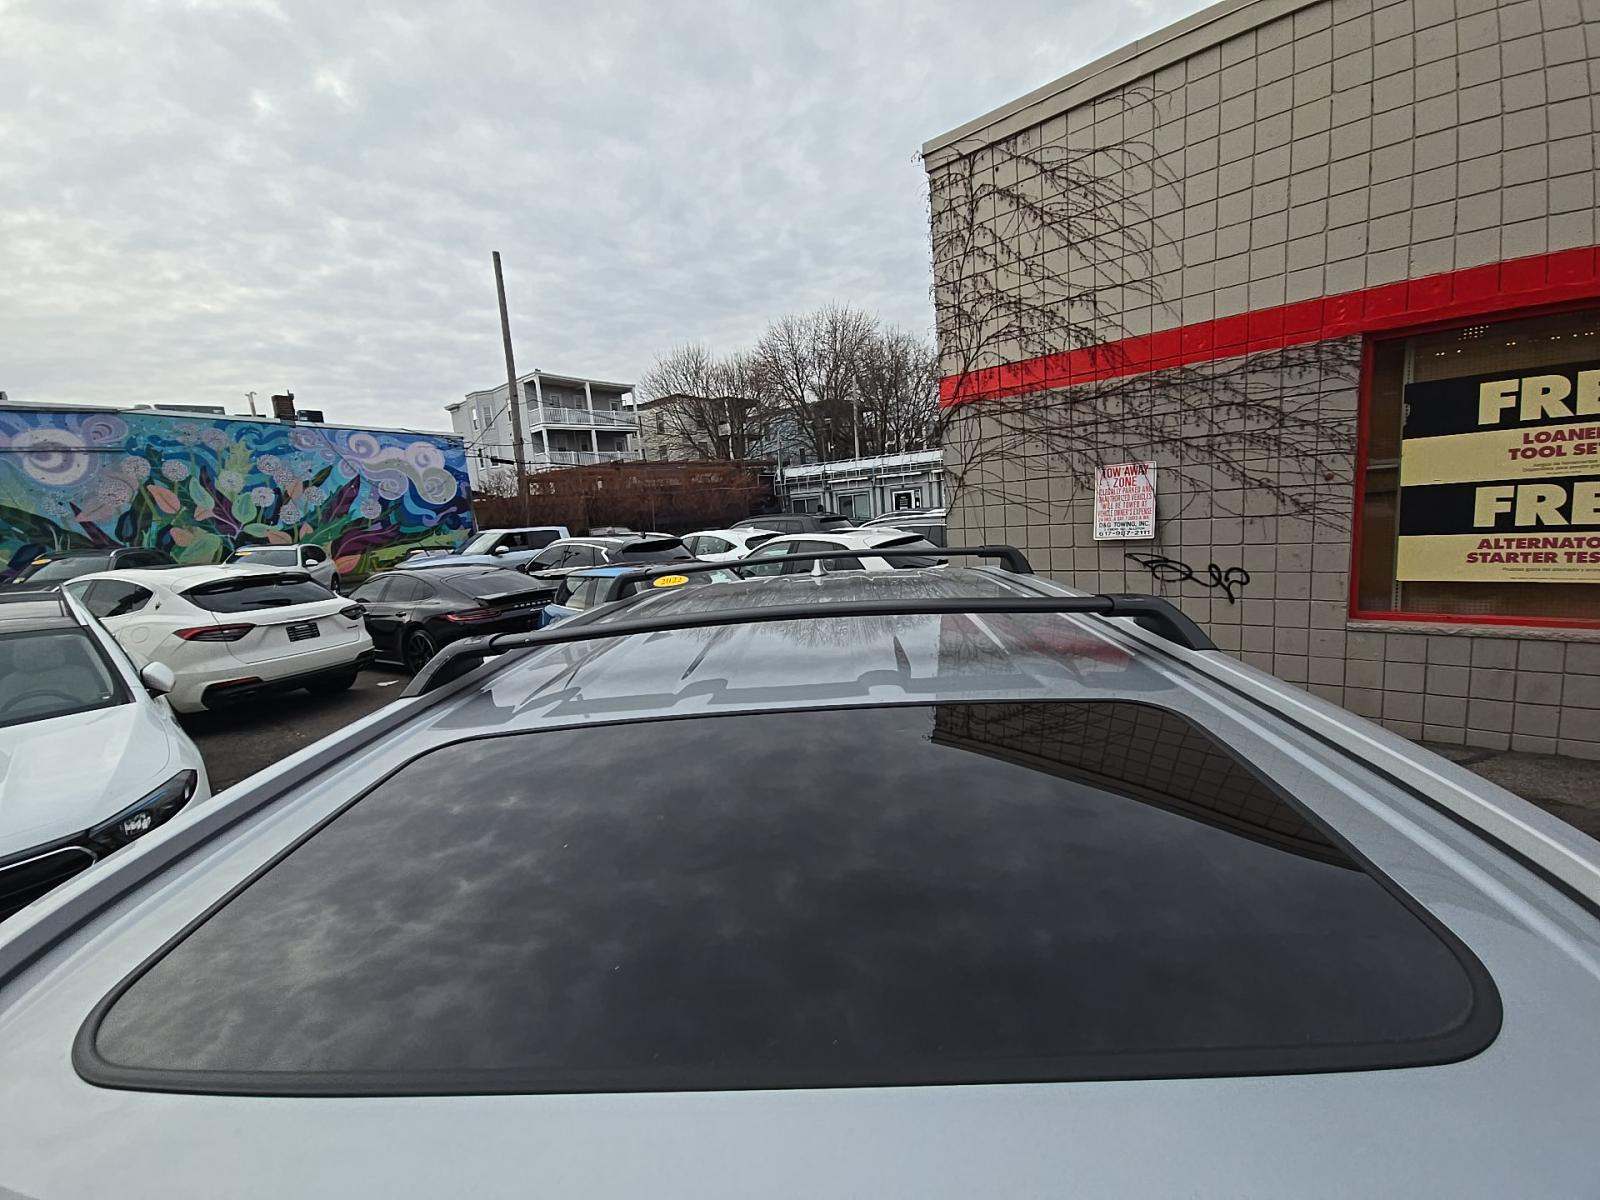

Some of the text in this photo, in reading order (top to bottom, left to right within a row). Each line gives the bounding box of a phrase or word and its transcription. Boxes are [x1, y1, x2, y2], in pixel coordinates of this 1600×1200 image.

[1478, 369, 1600, 425] FRE
[1523, 427, 1600, 444] LOANE
[1508, 442, 1600, 460] TOOL SE
[1101, 464, 1149, 479] TOW AWAY
[1113, 477, 1136, 488] ZONE
[1473, 481, 1600, 527] FRE
[1477, 537, 1600, 549] ALTERNATO
[1466, 552, 1600, 563] STARTER TES
